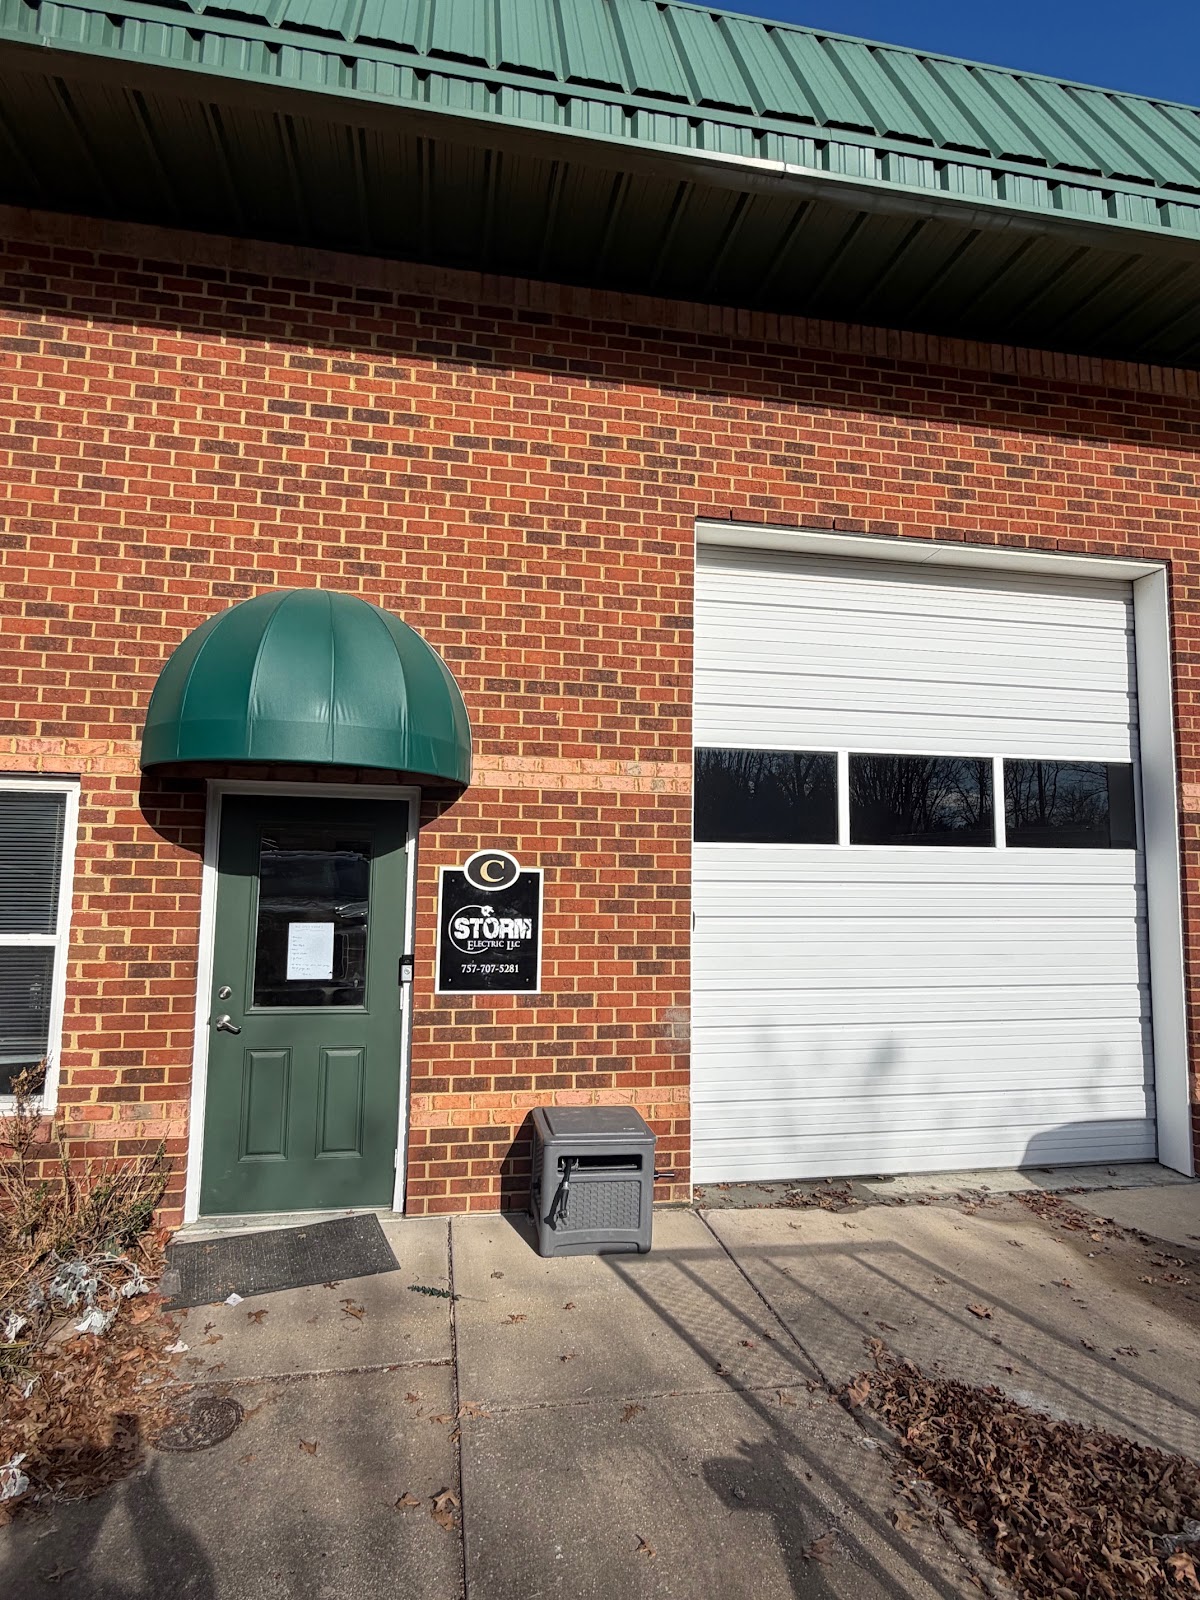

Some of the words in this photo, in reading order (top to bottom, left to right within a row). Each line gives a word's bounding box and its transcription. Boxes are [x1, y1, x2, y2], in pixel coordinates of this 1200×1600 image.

[480, 860, 505, 882] C
[454, 918, 532, 939] STORM
[467, 940, 504, 950] ELECTRIC
[506, 940, 520, 950] LLC
[461, 964, 519, 973] 757-707-5281
